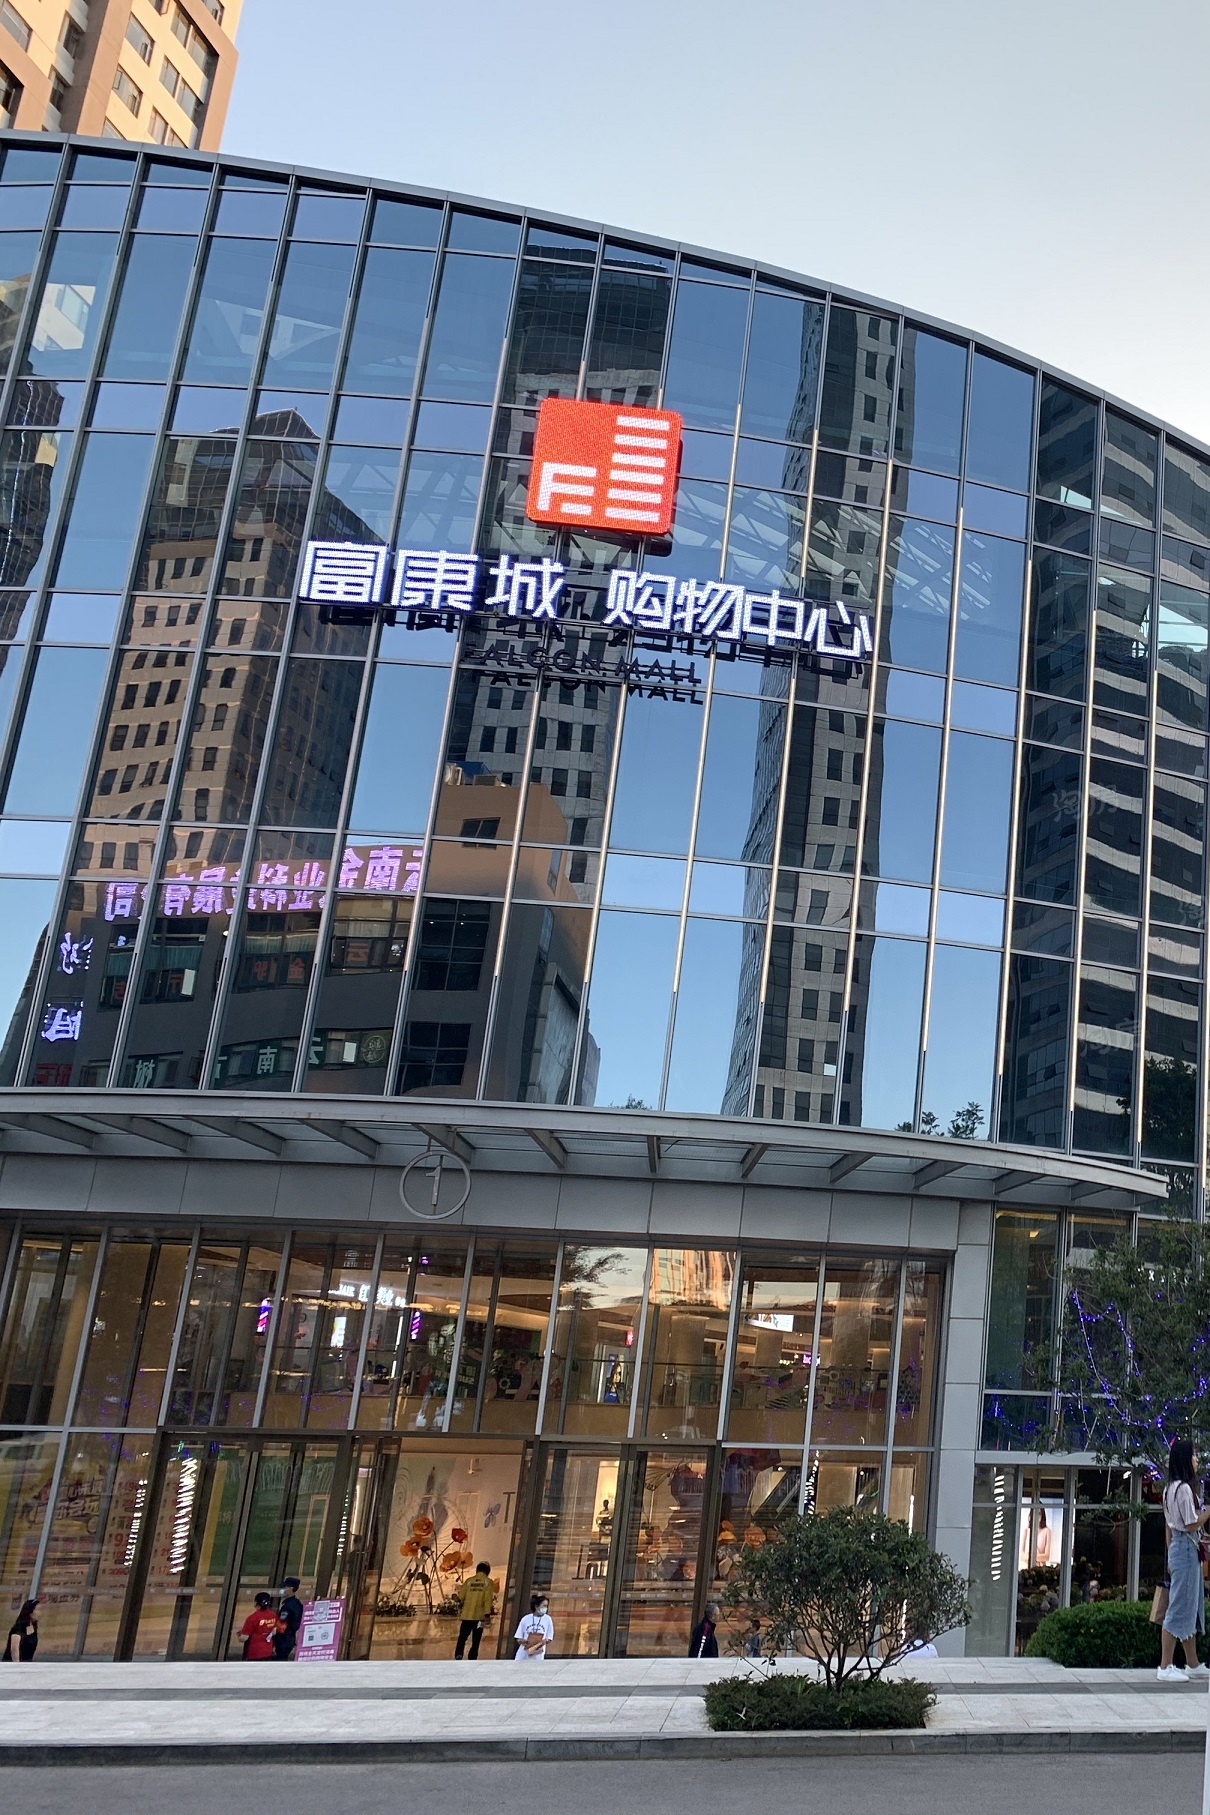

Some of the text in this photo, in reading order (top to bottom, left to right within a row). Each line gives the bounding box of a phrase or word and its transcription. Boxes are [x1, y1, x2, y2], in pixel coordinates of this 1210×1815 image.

[299, 540, 875, 658] 富康城 购物中心
[461, 643, 702, 684] FALCON MALL
